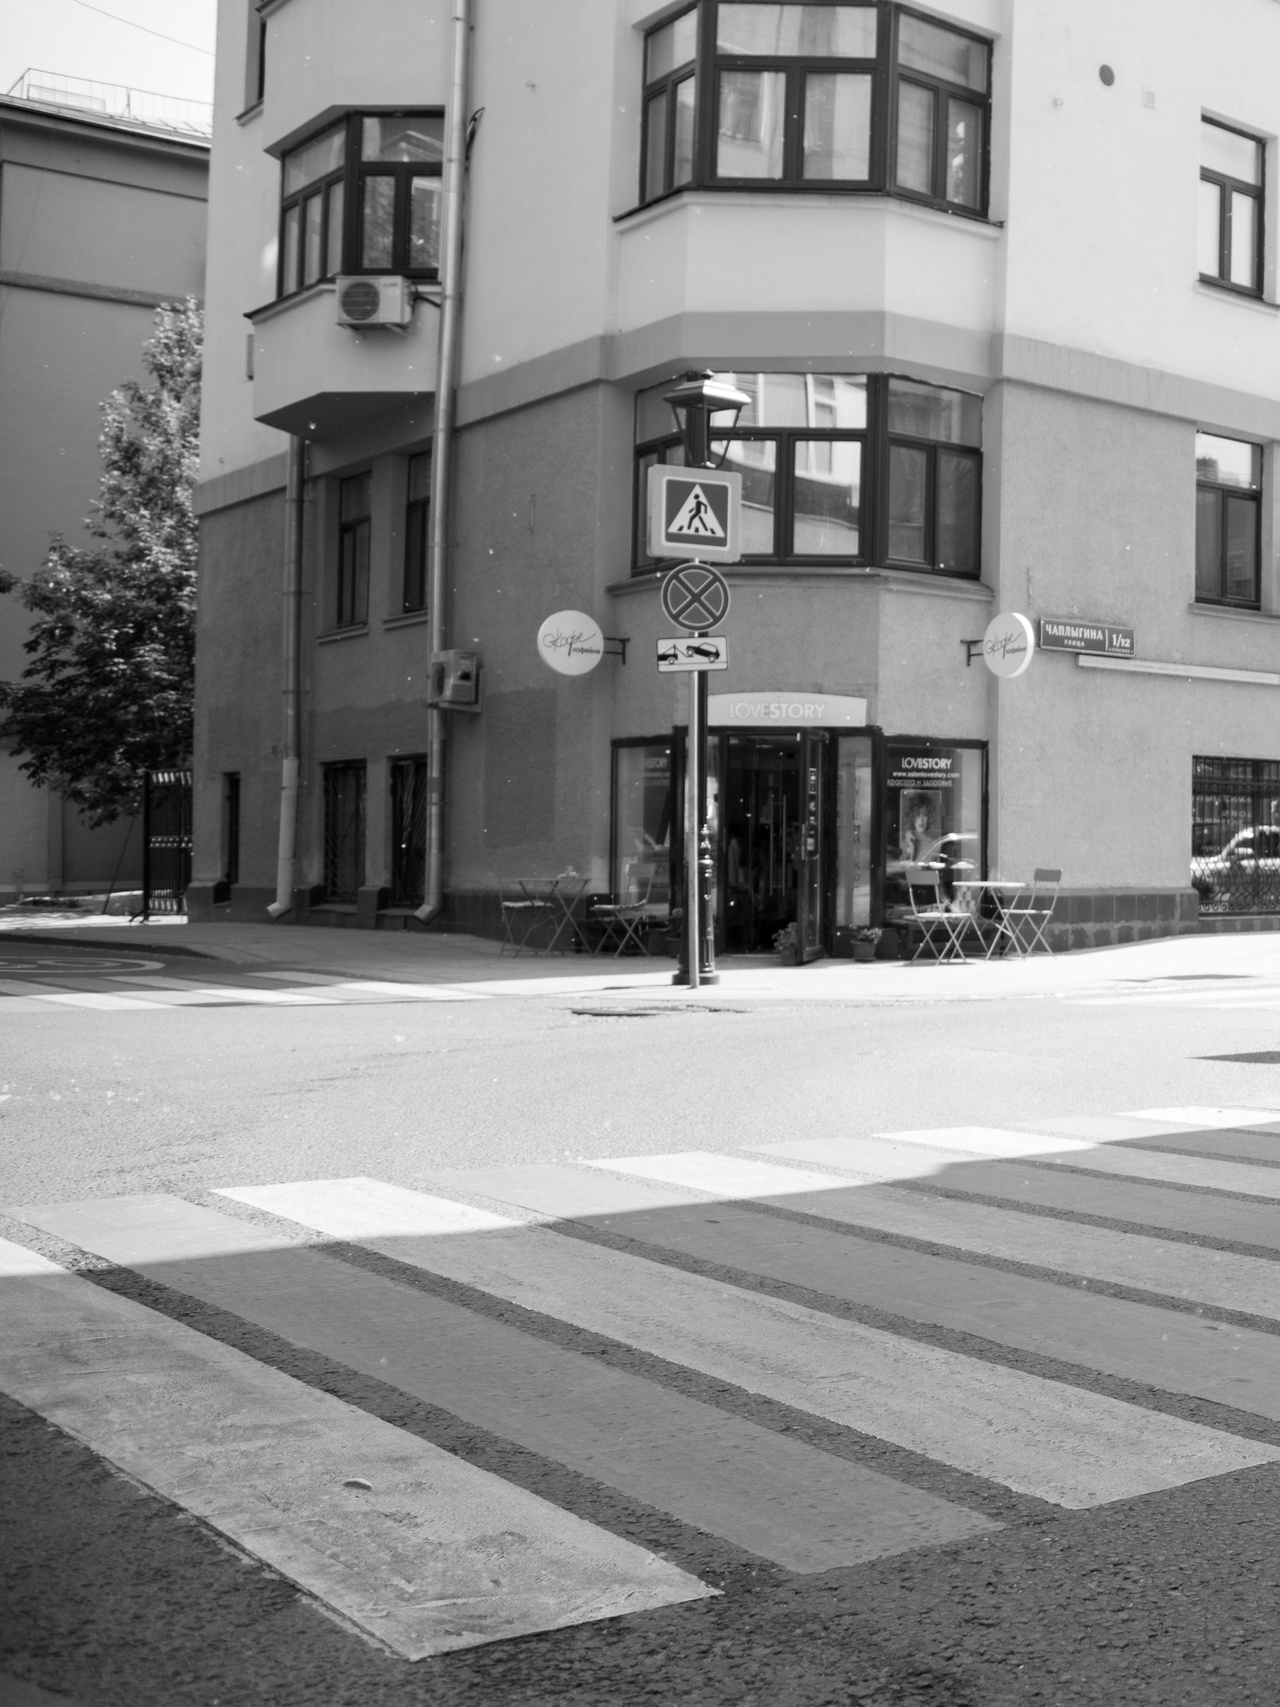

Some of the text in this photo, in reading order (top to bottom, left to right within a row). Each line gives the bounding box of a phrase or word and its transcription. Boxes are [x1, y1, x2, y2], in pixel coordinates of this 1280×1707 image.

[1045, 624, 1103, 640] ЧАПЛЫГИНА
[1064, 639, 1085, 647] УЛИЦА
[1112, 633, 1131, 648] 1/12
[730, 702, 826, 719] LOVESTORY
[902, 757, 952, 769] LOVESTORY
